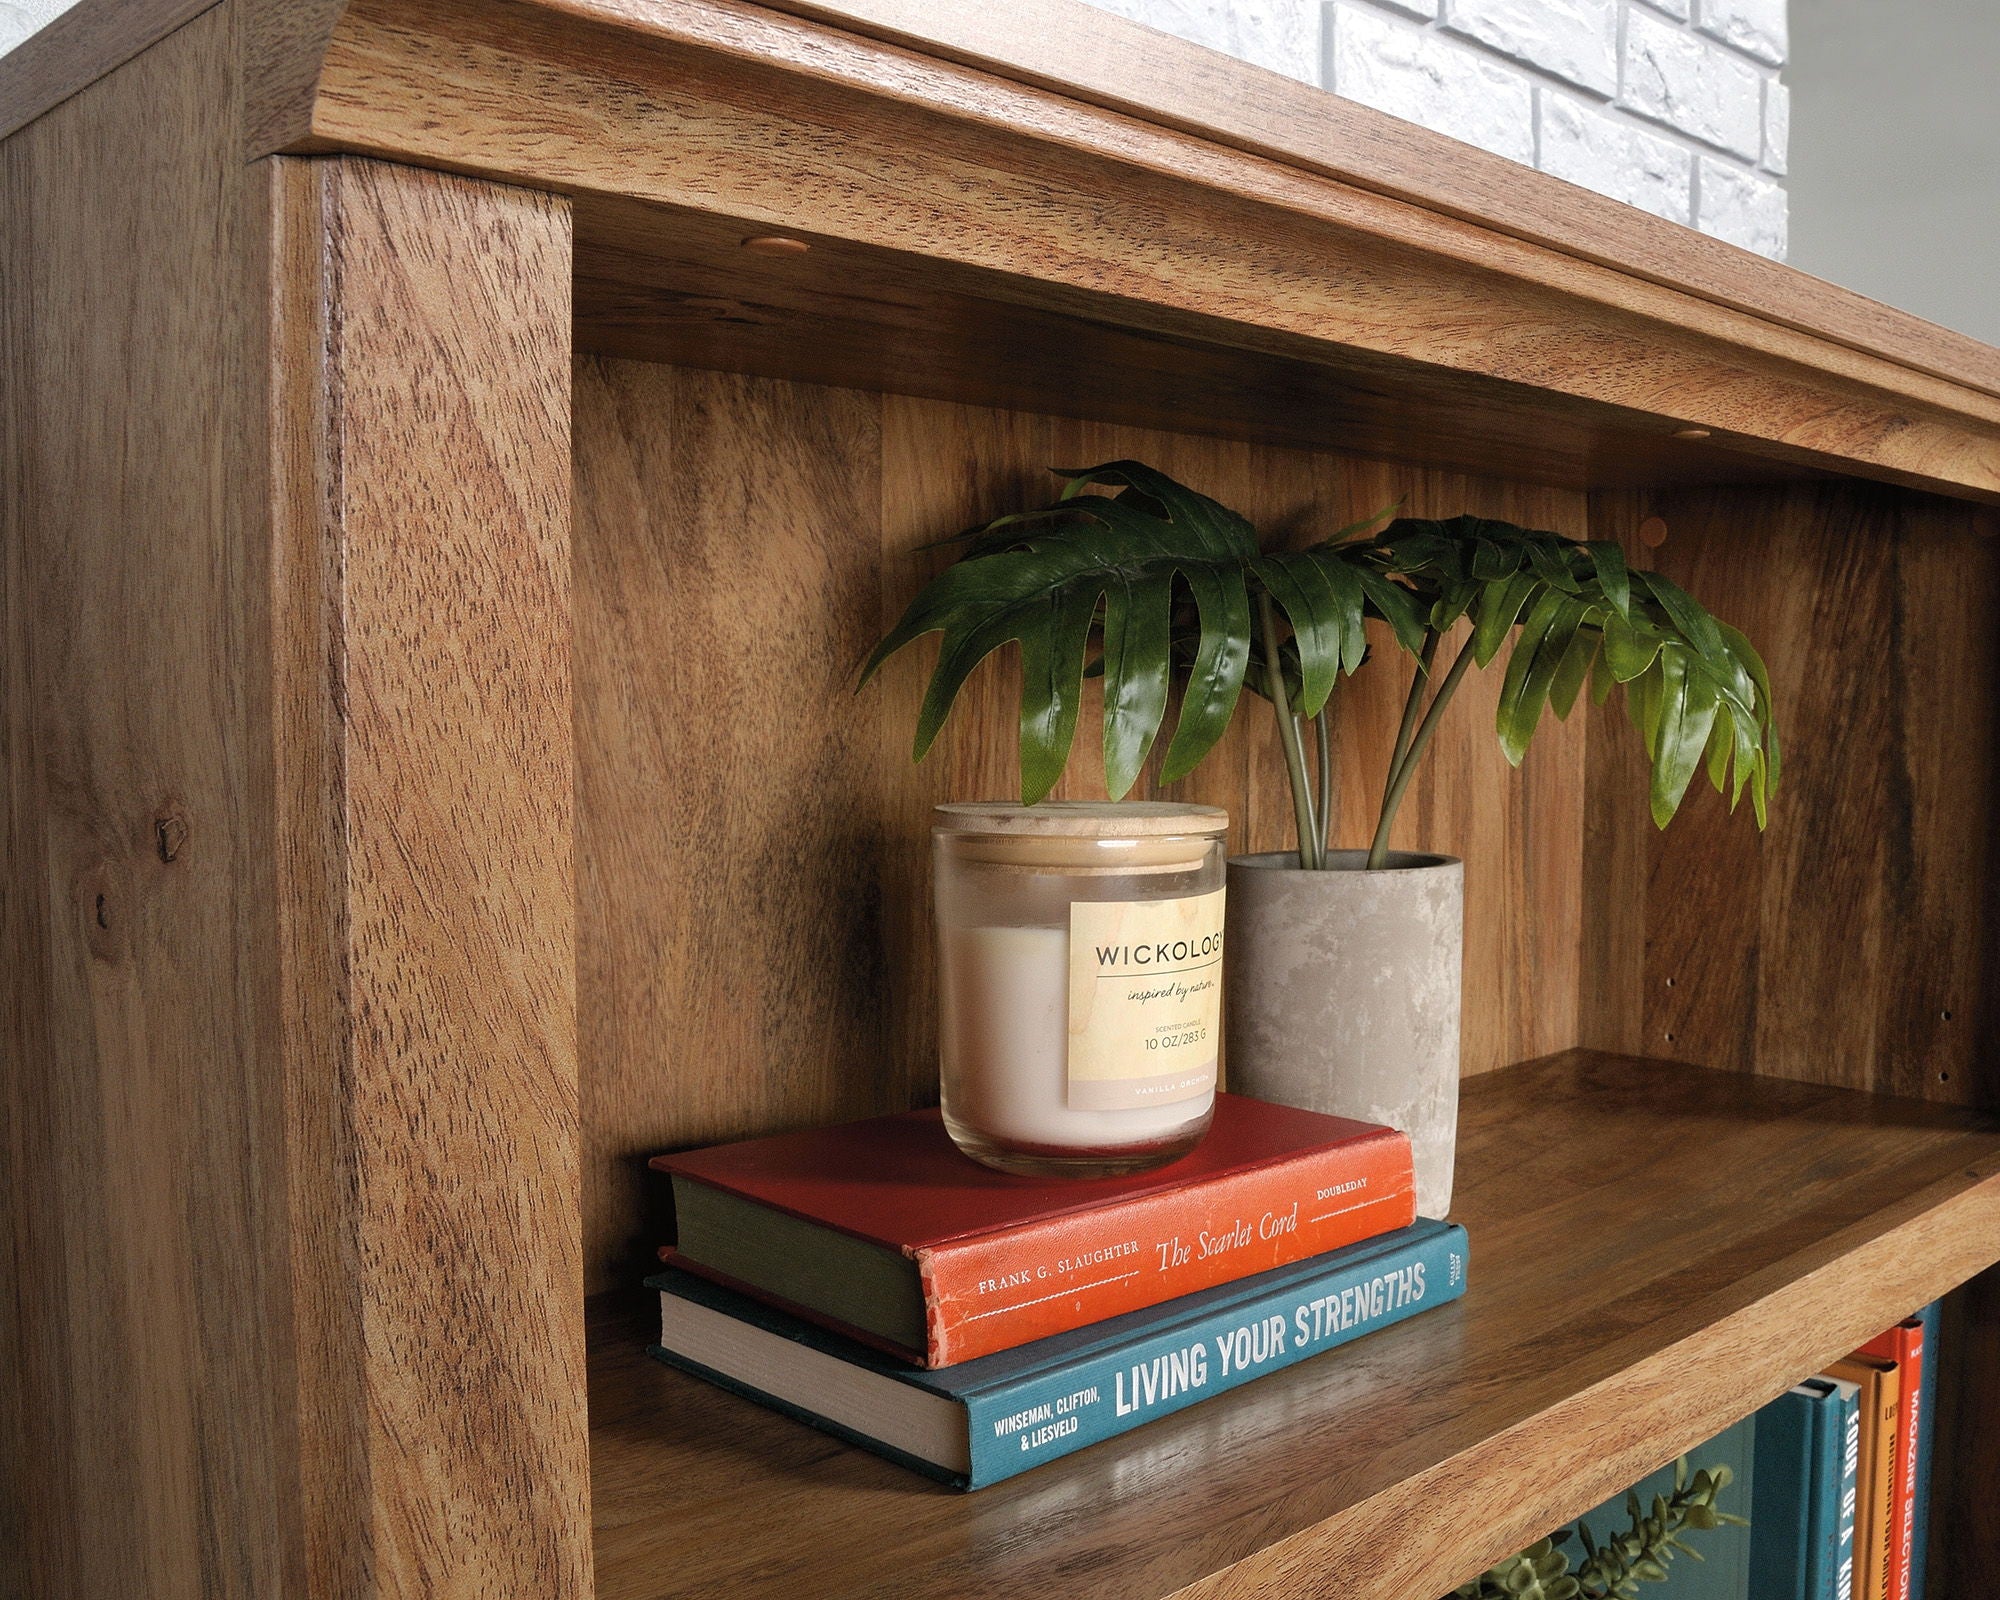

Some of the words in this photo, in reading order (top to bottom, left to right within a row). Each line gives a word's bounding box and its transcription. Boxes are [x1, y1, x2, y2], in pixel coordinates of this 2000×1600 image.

[1128, 982, 1175, 1005] inspired
[1176, 982, 1188, 1003] by
[1145, 1038, 1158, 1050] 10
[1162, 1030, 1199, 1049] OZ/283
[1155, 1023, 1182, 1033] SCENTED
[1183, 1019, 1201, 1029] CANDLE
[1135, 1083, 1176, 1095] VANILLA
[1316, 1177, 1368, 1200] DOUBLEDAY
[1155, 1236, 1191, 1273] The
[1197, 1219, 1253, 1261] Scarlet
[1259, 1202, 1299, 1241] Cord
[978, 1269, 1032, 1295] FRANK
[1036, 1266, 1052, 1280] G.
[1058, 1240, 1140, 1274] SLAUGHTER
[1115, 1342, 1208, 1418] LIVING
[1216, 1314, 1287, 1377] YOUR
[1294, 1261, 1426, 1348] STRENGTHS
[994, 1403, 1054, 1437] WINSEMAN,
[1056, 1386, 1101, 1415] CLIFTON,
[1020, 1434, 1030, 1452] &
[1031, 1416, 1078, 1448] LIESVELD
[1844, 1410, 1860, 1479] FOUR
[1905, 1388, 1920, 1494] MAGAZINE
[1842, 1487, 1856, 1519] OF
[1840, 1525, 1855, 1547] A
[1899, 1496, 1914, 1600] SELECTION
[1837, 1556, 1853, 1600] KIN
